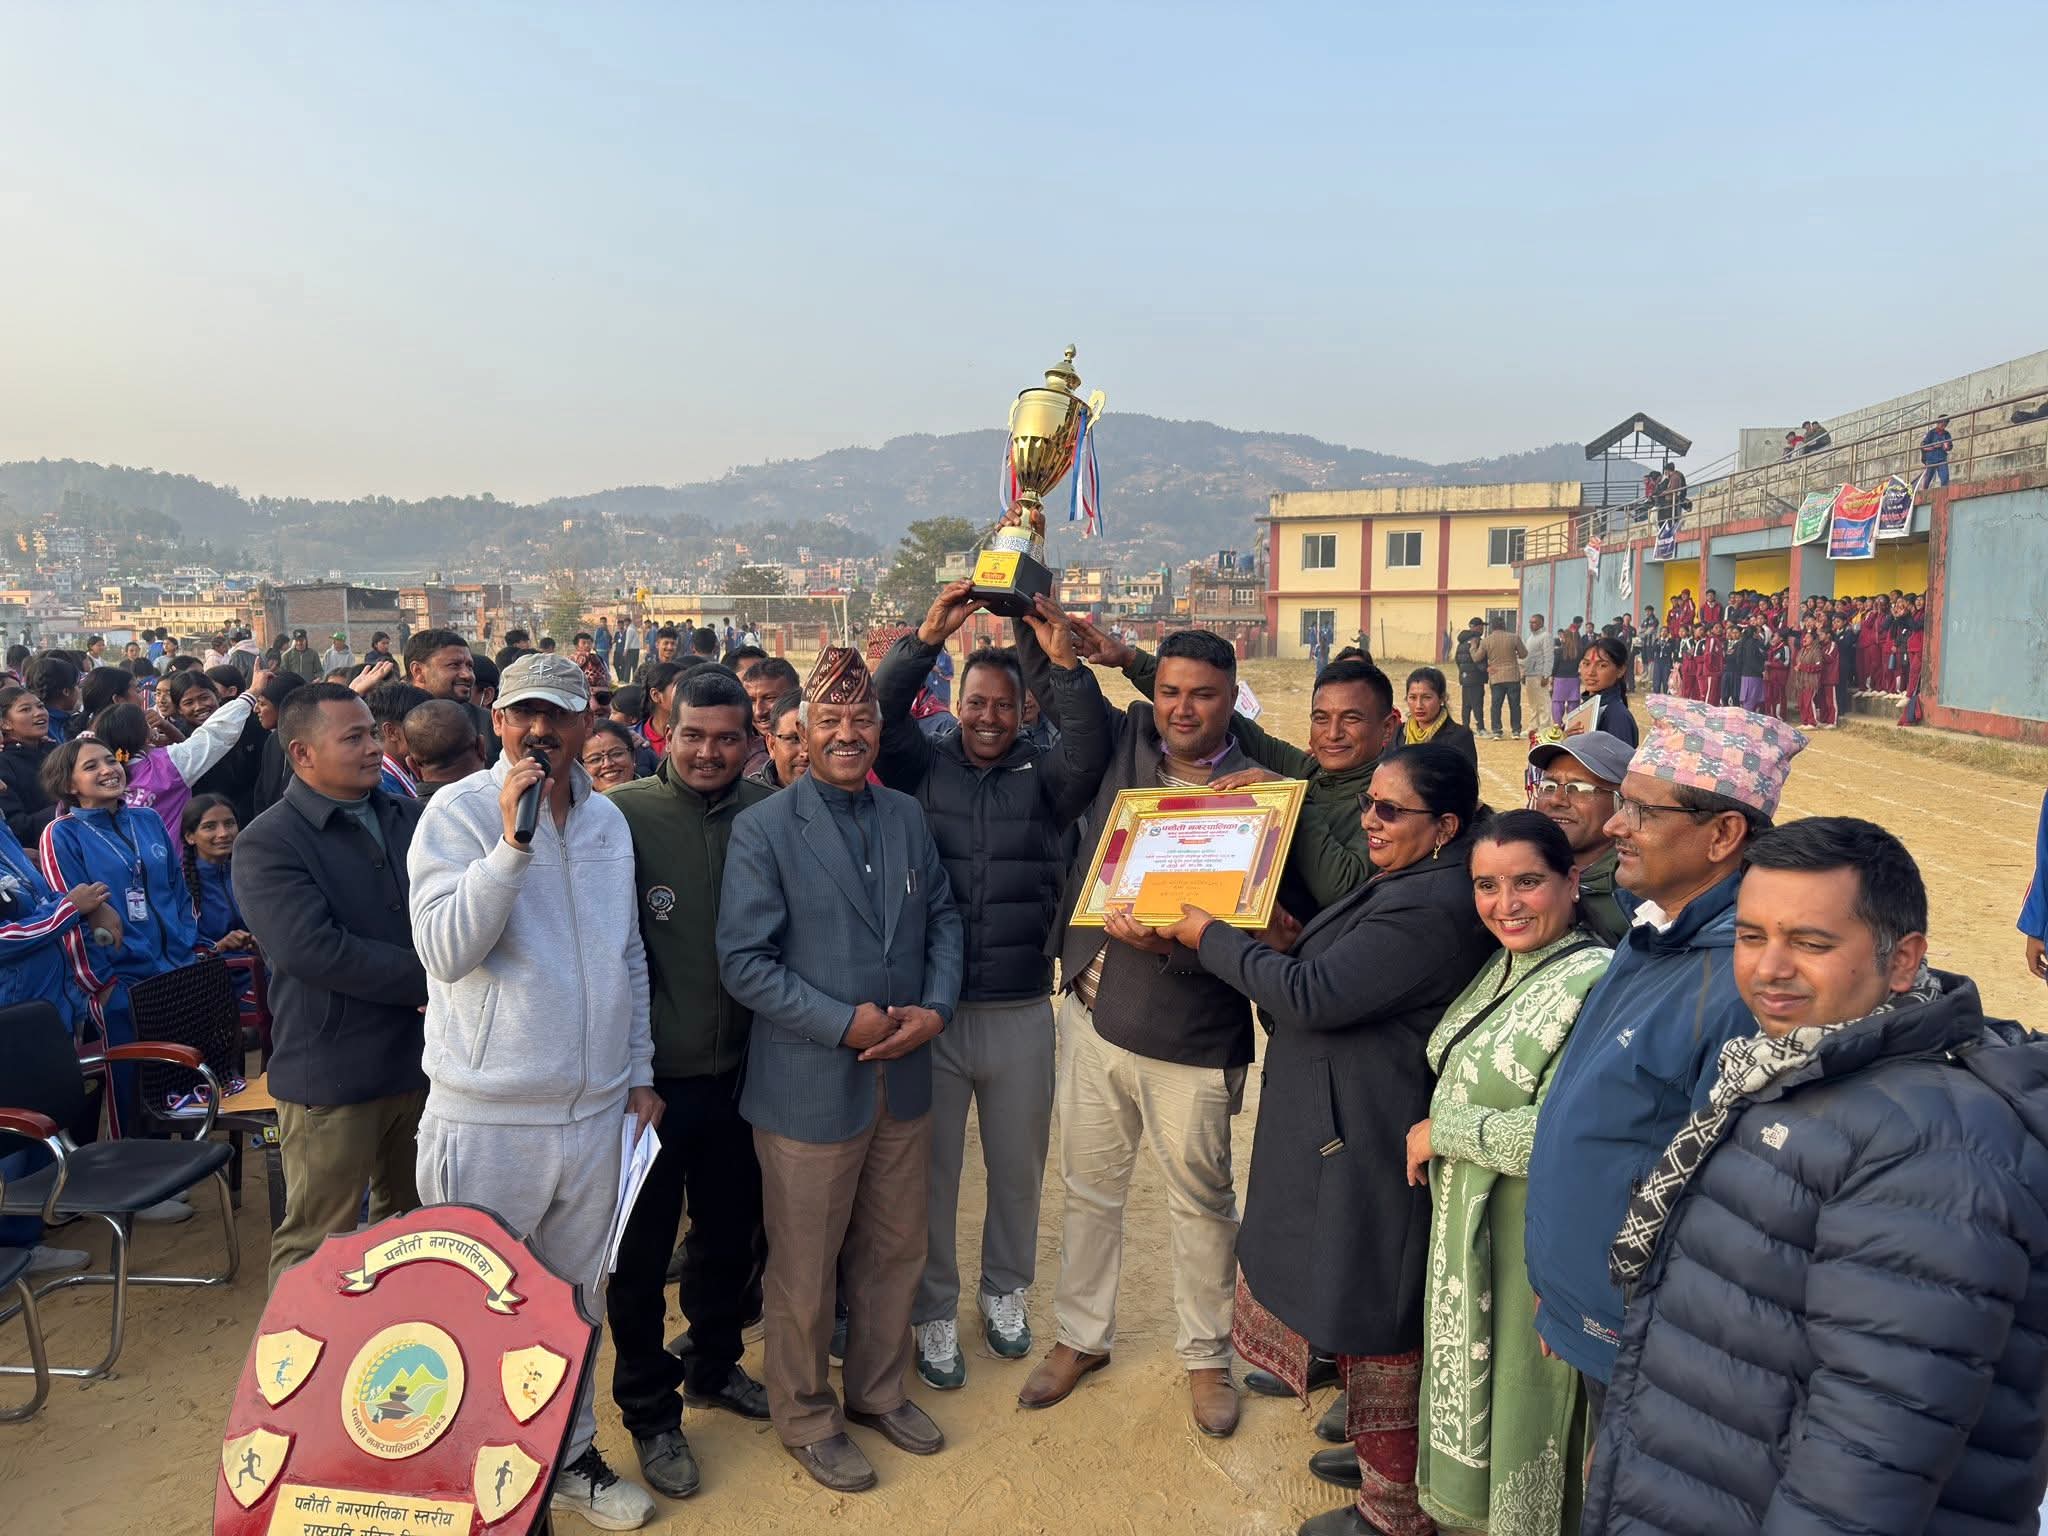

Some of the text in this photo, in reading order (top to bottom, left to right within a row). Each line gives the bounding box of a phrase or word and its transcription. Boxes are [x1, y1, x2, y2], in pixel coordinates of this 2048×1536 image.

[384, 1234, 494, 1276] पनौती नगरपालिका
[295, 1492, 454, 1528] पनौती नगरपालिका स्तरीय
